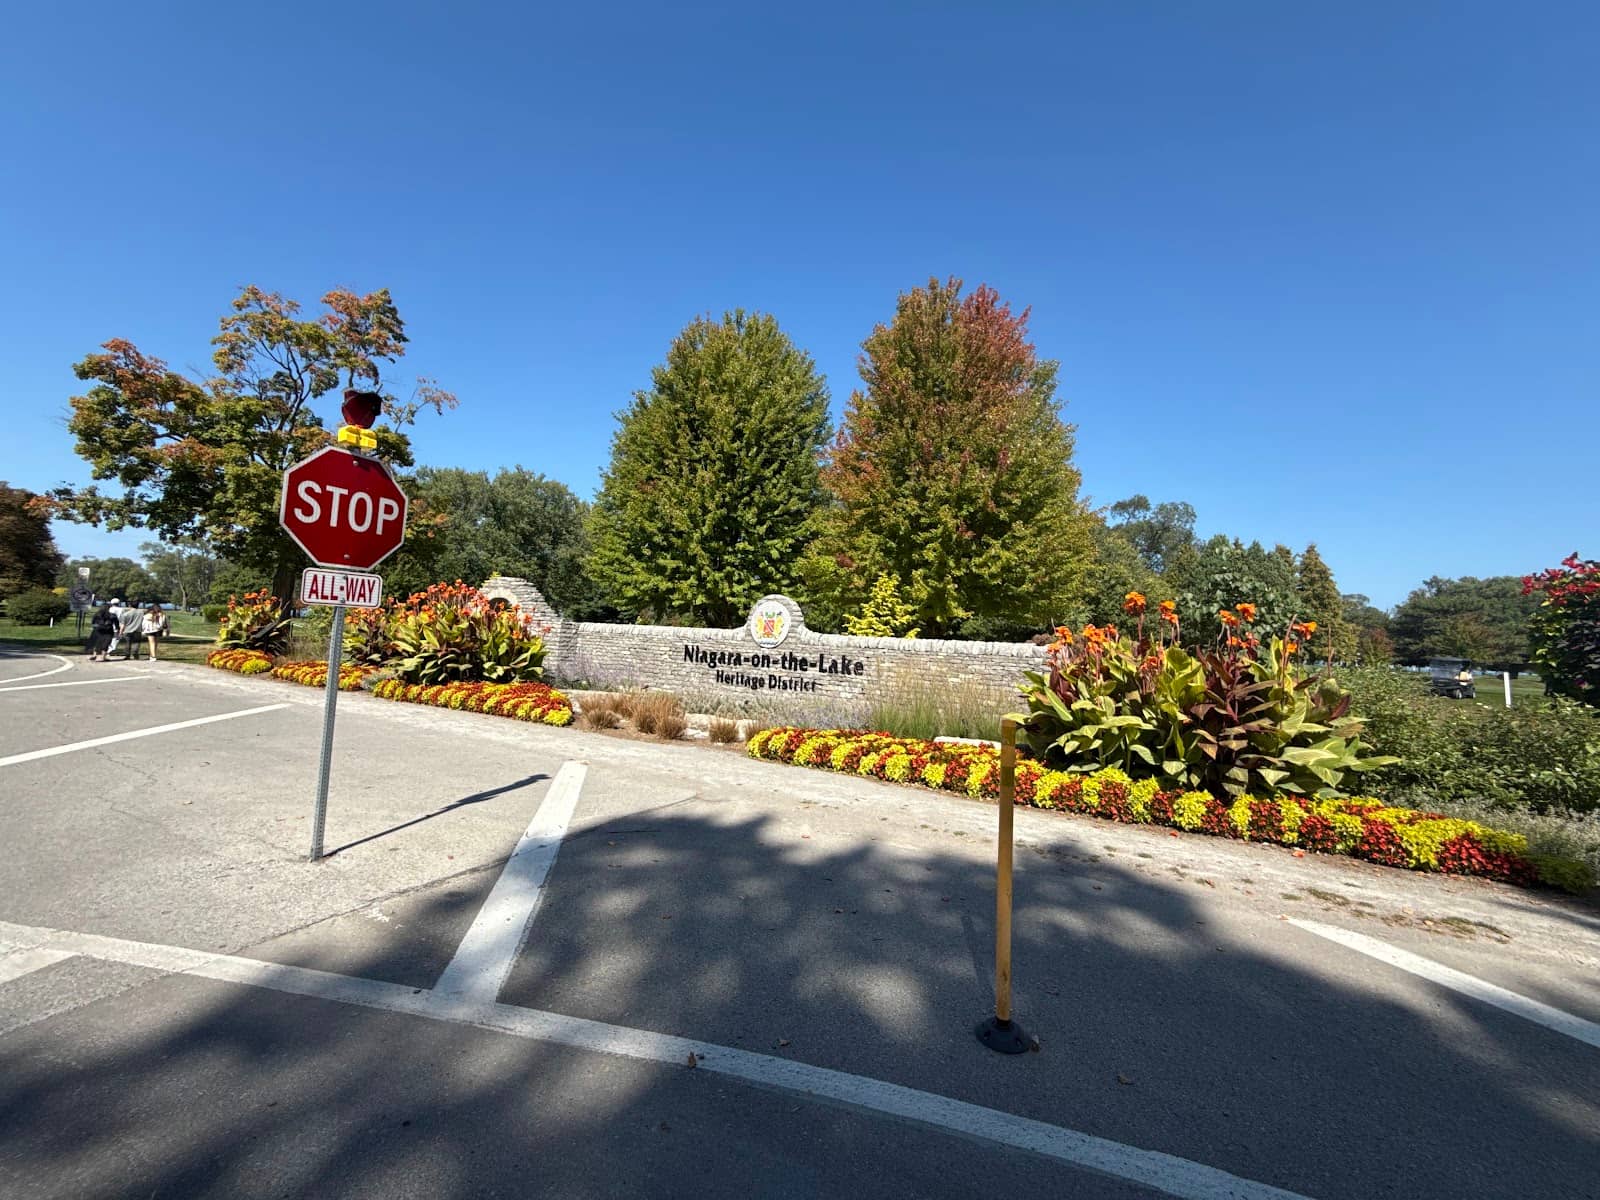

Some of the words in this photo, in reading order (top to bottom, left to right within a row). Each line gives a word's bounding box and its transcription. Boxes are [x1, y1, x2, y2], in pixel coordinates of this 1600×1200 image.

[294, 480, 399, 535] STOP
[684, 645, 864, 676] Niagara-on-the-Lake
[716, 670, 765, 690] Heritage
[768, 675, 817, 692] District
